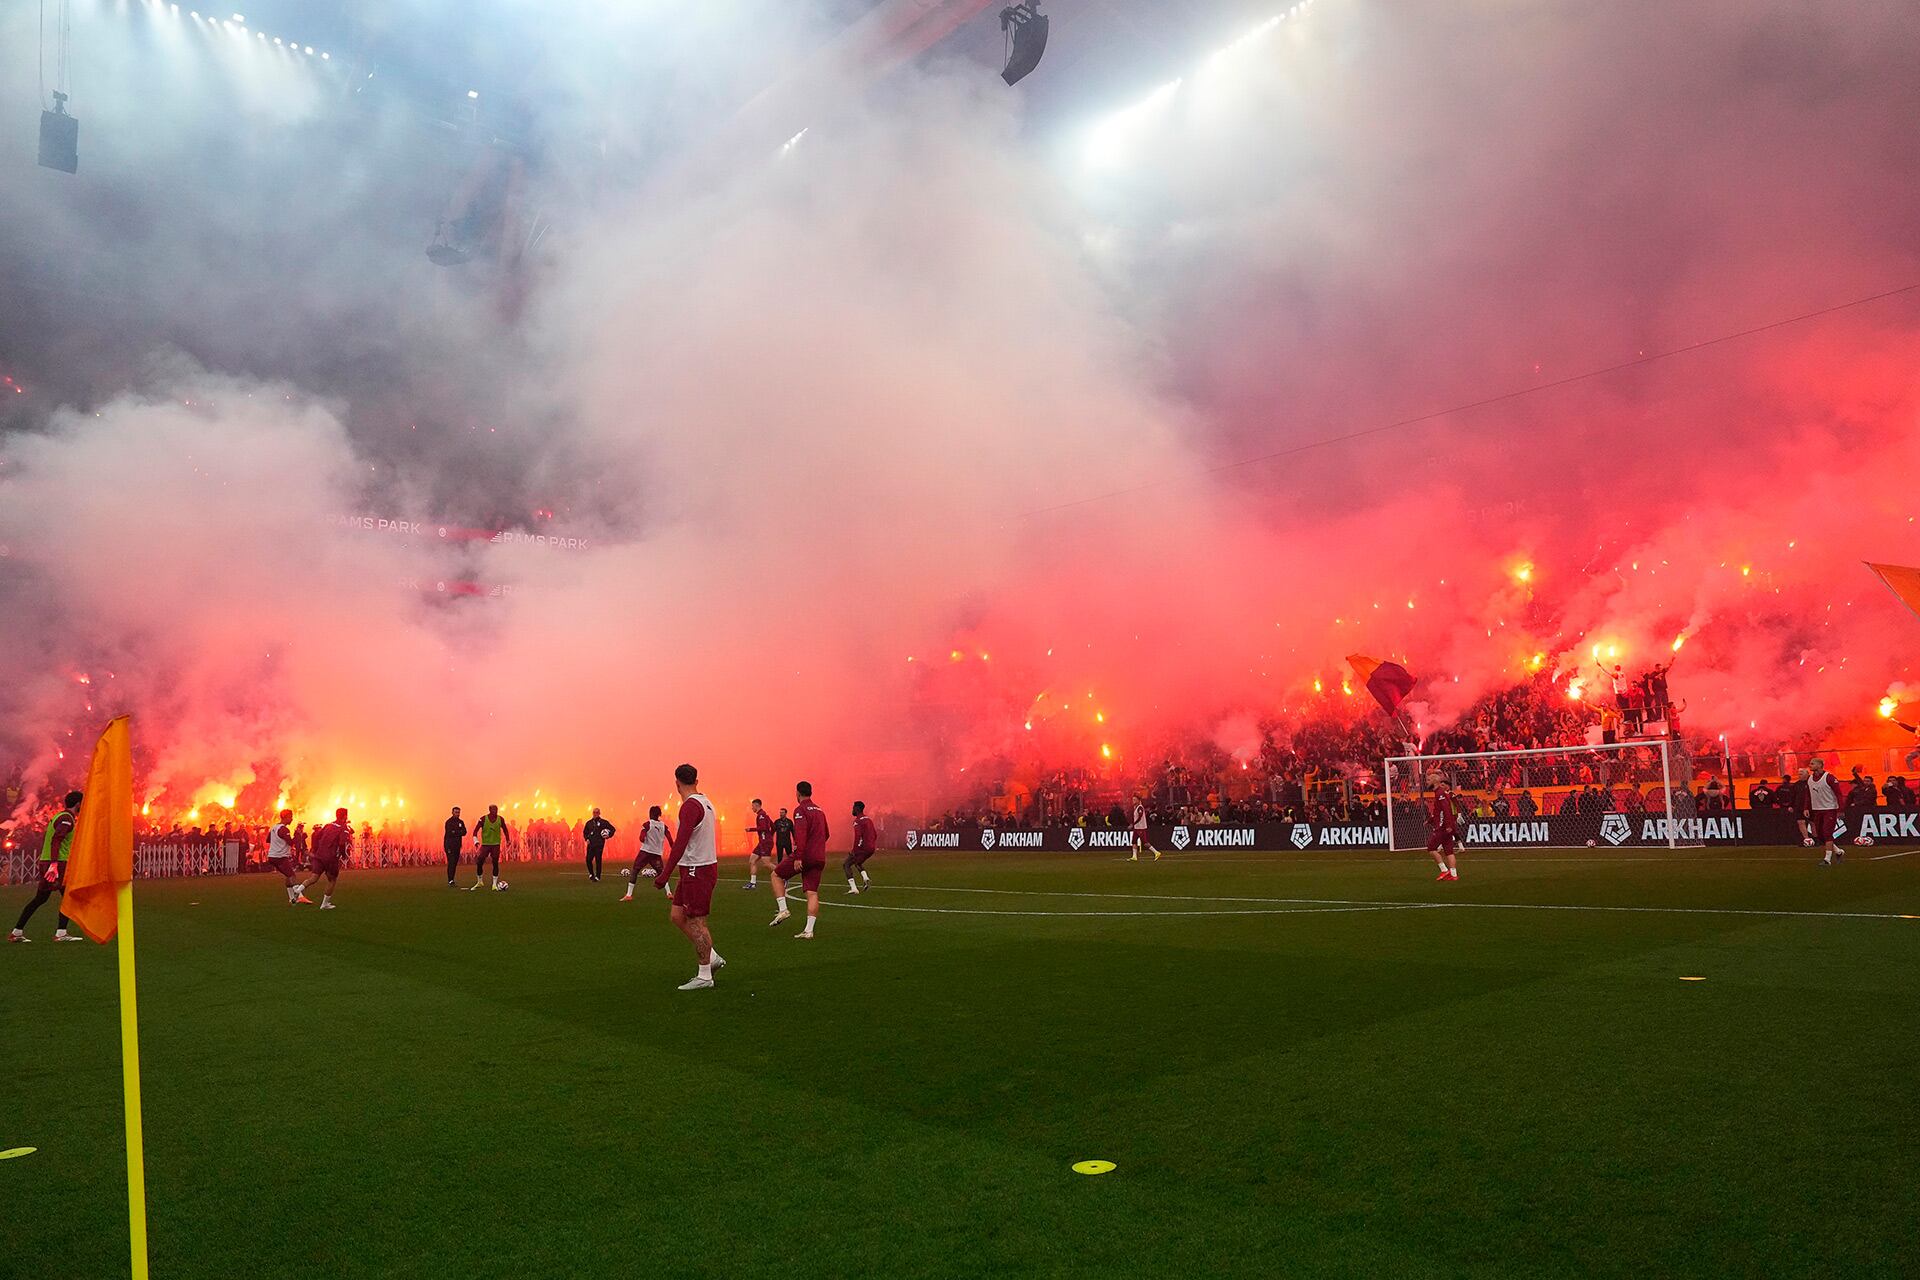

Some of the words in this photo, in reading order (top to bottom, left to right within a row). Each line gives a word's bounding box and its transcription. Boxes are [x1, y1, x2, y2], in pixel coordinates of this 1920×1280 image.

[378, 518, 421, 534] PARK
[503, 531, 546, 546] RAMS
[549, 536, 588, 550] PARK
[1465, 822, 1549, 842] ARKHAM
[1642, 817, 1743, 840] ARKHAM
[1858, 813, 1920, 837] ARK
[920, 833, 960, 847] ARKHAM
[999, 832, 1043, 847] ARKHAM
[1195, 829, 1255, 846] ARKHAM
[1319, 826, 1389, 845] ARKHAM
